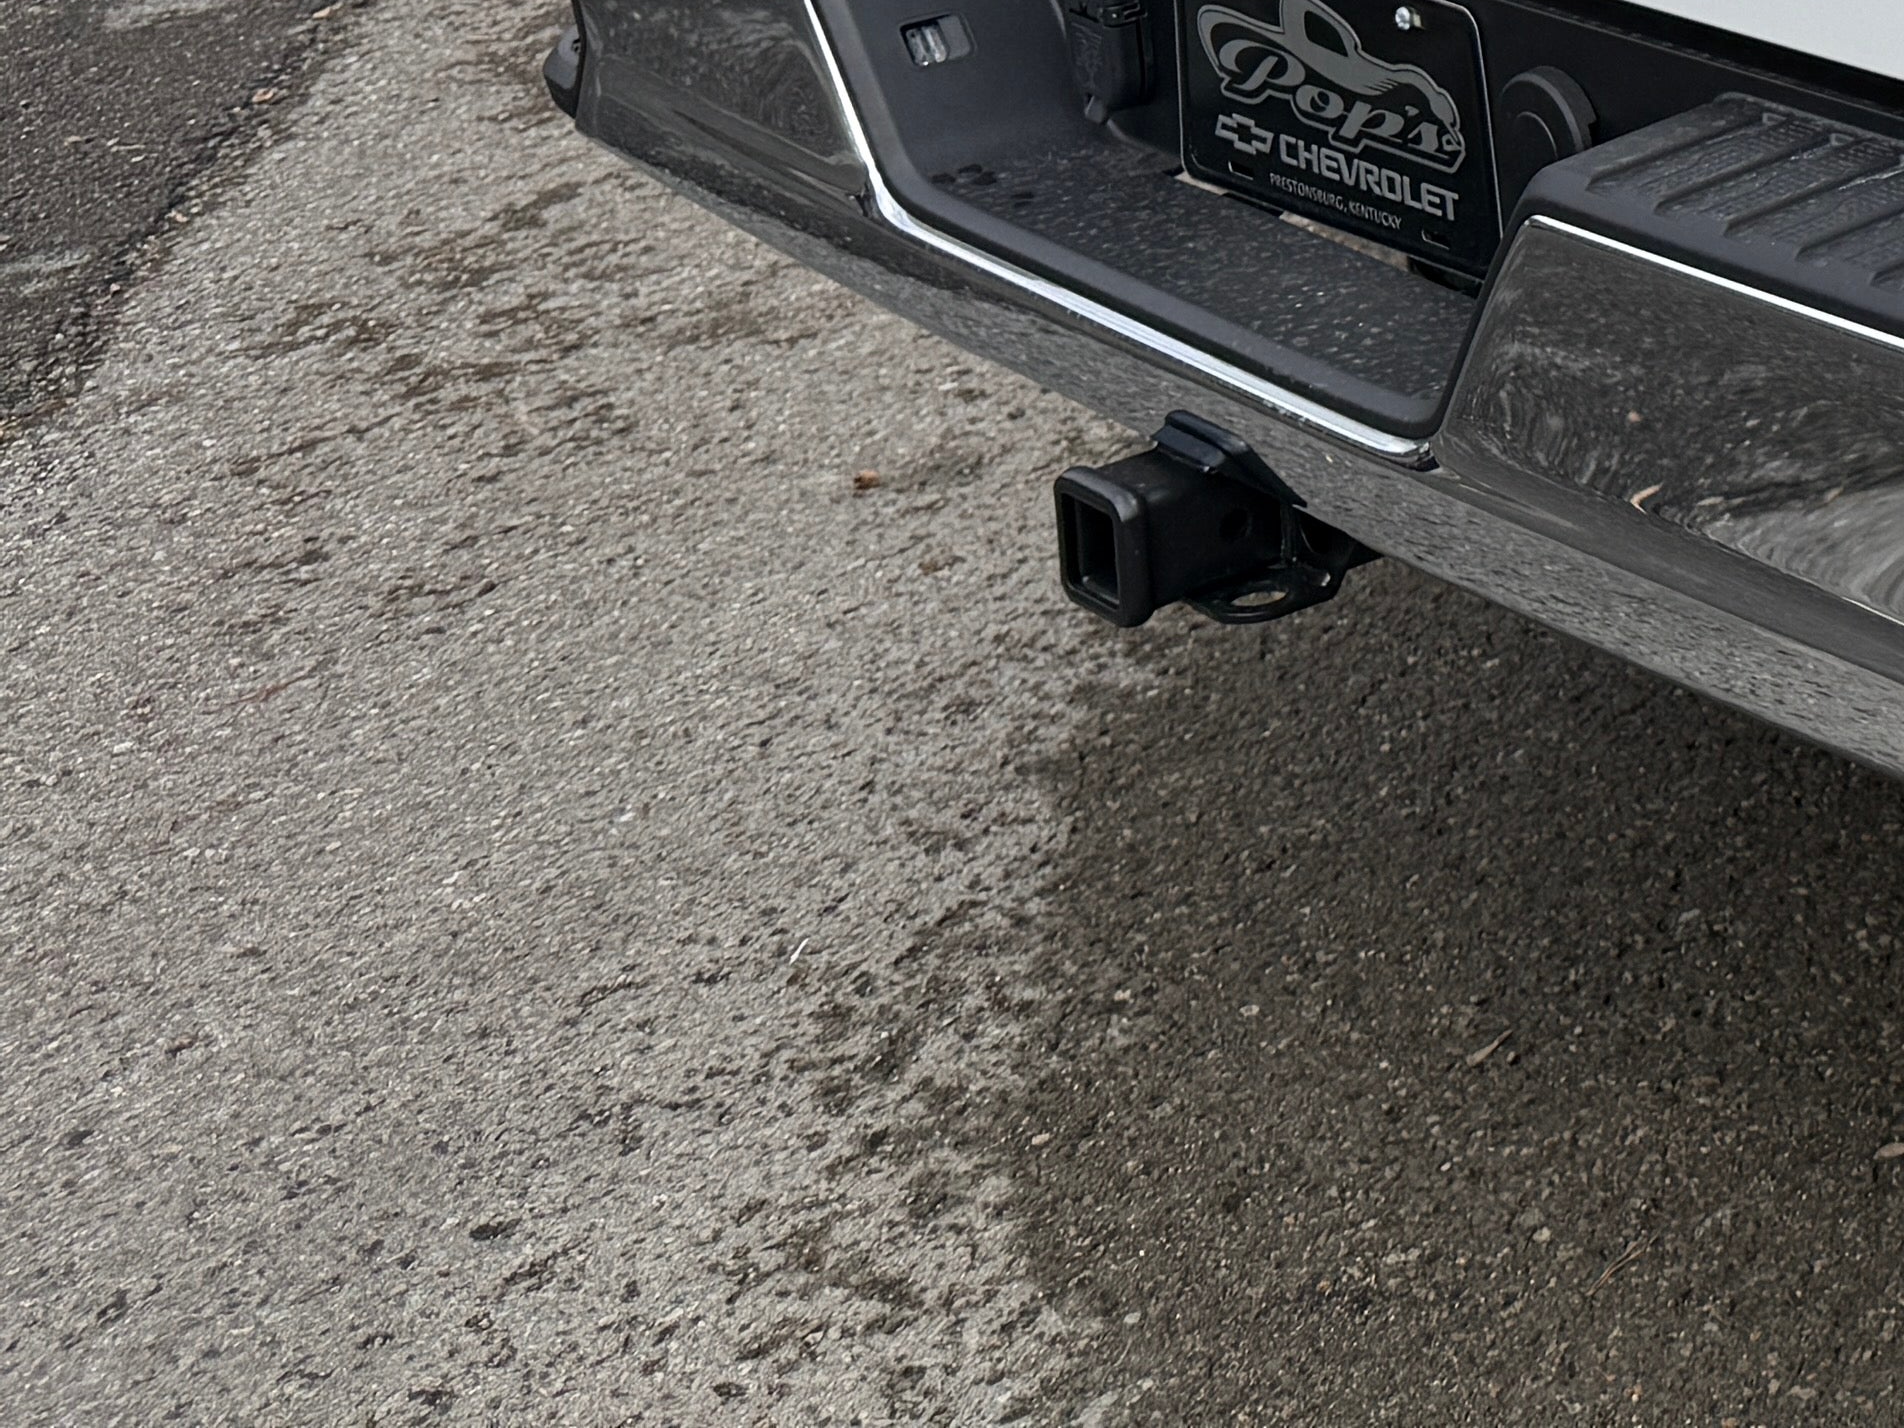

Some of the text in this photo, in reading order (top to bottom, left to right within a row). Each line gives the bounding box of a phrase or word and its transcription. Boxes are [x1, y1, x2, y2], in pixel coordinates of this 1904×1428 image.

[1219, 38, 1463, 160] Pop's
[1269, 172, 1402, 230] PRESTONSBURG, KENTUCKY
[1279, 133, 1459, 222] CHEVROLET
